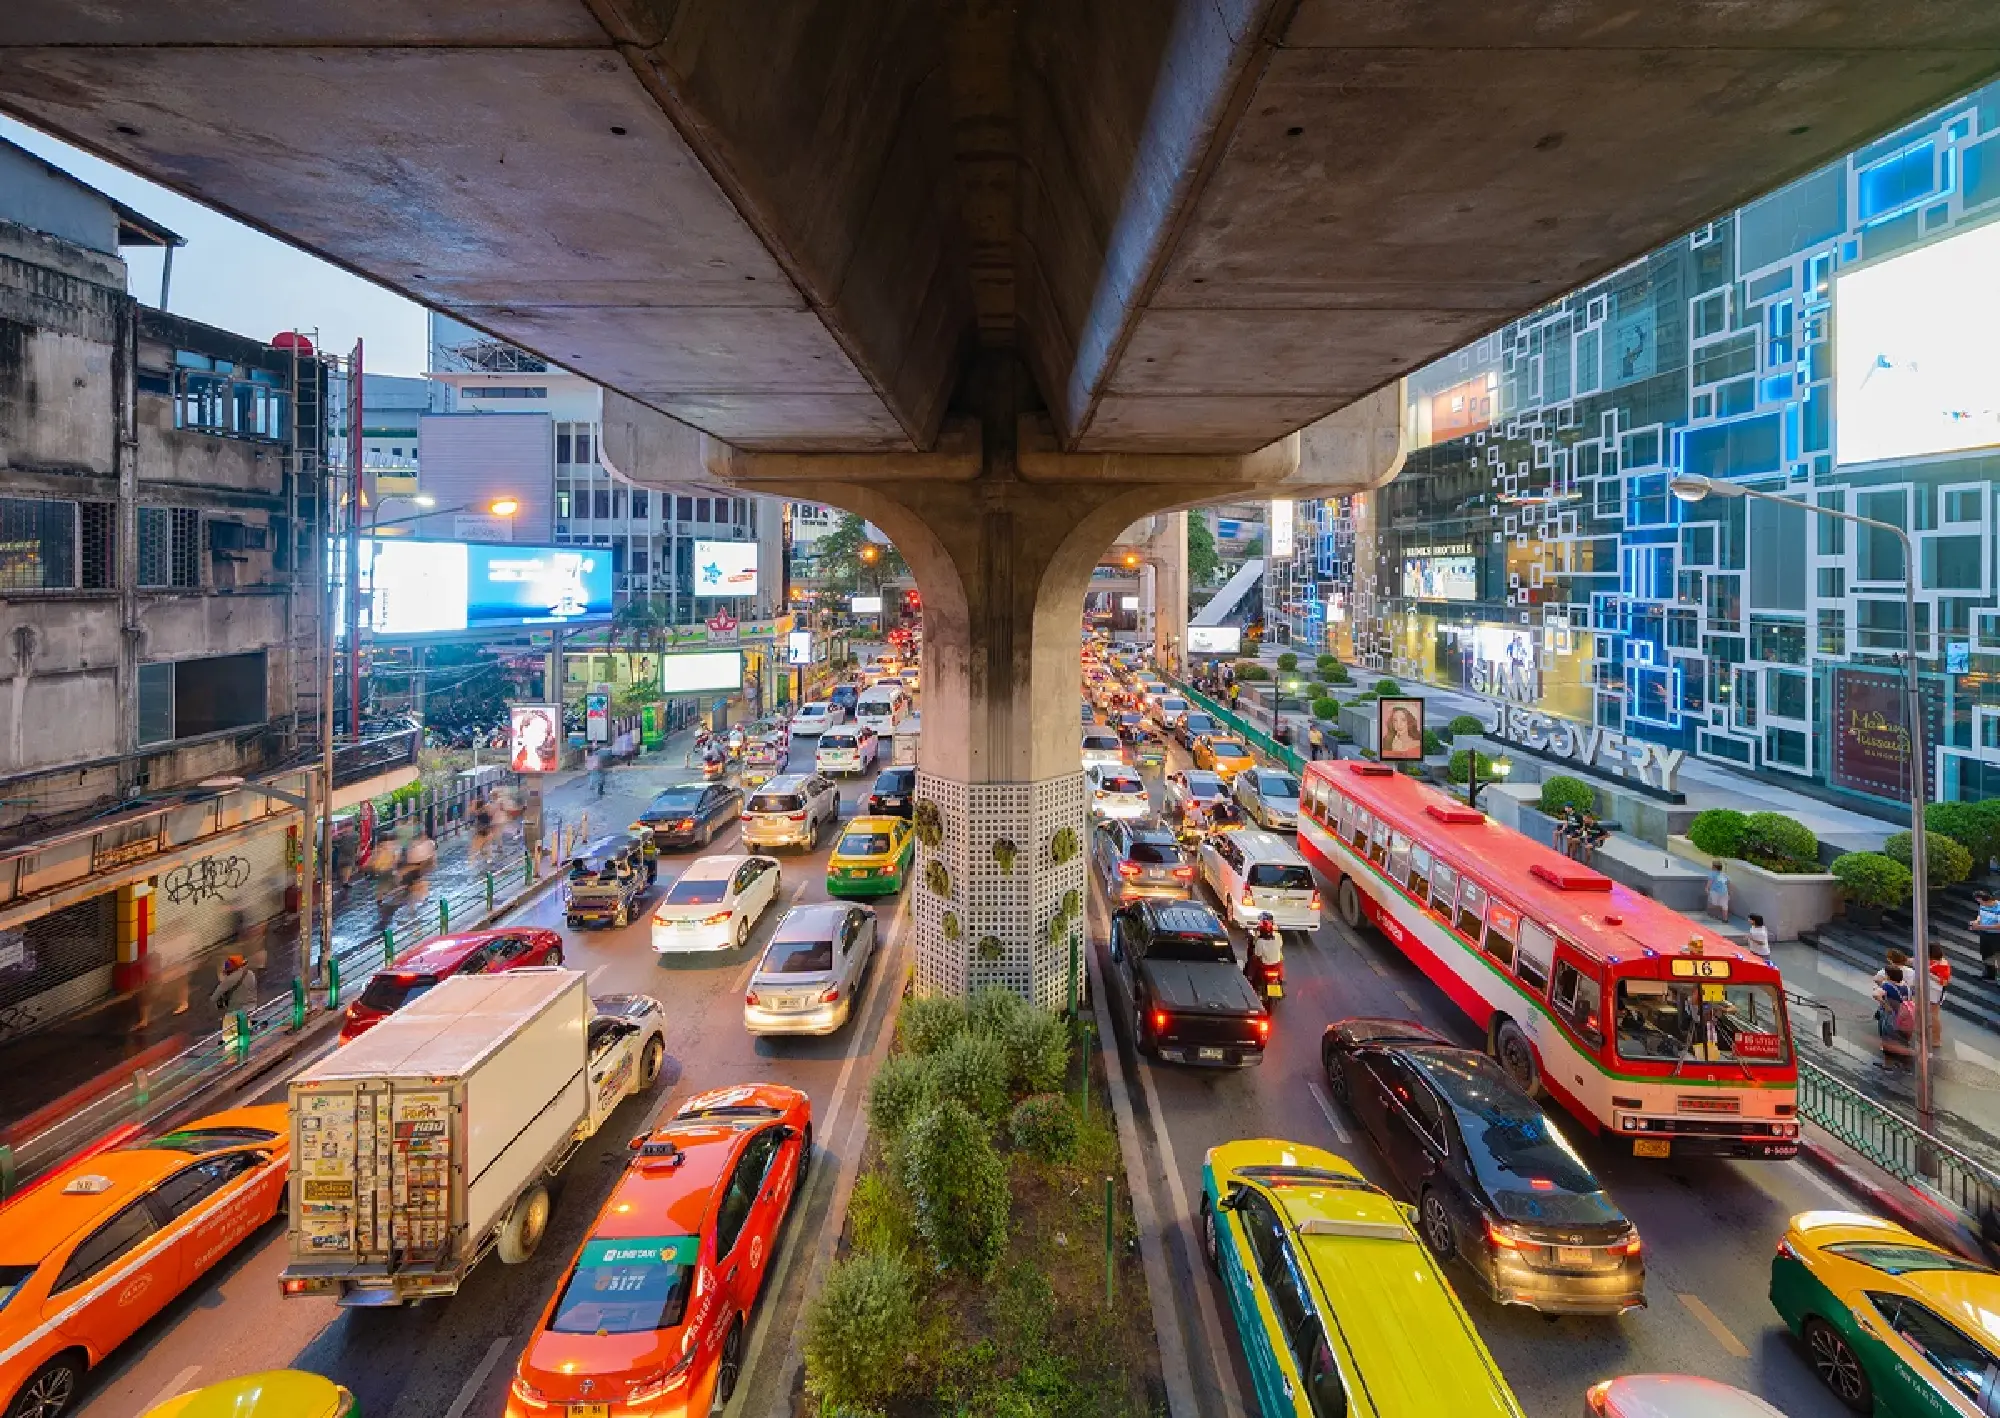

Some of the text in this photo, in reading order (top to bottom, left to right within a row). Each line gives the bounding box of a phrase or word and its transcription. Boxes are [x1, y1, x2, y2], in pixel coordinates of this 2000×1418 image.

[1470, 658, 1542, 704] SIAM
[1482, 700, 1686, 792] DISCOVERY
[1854, 727, 1911, 753] Tussaud
[1692, 961, 1713, 976] 16
